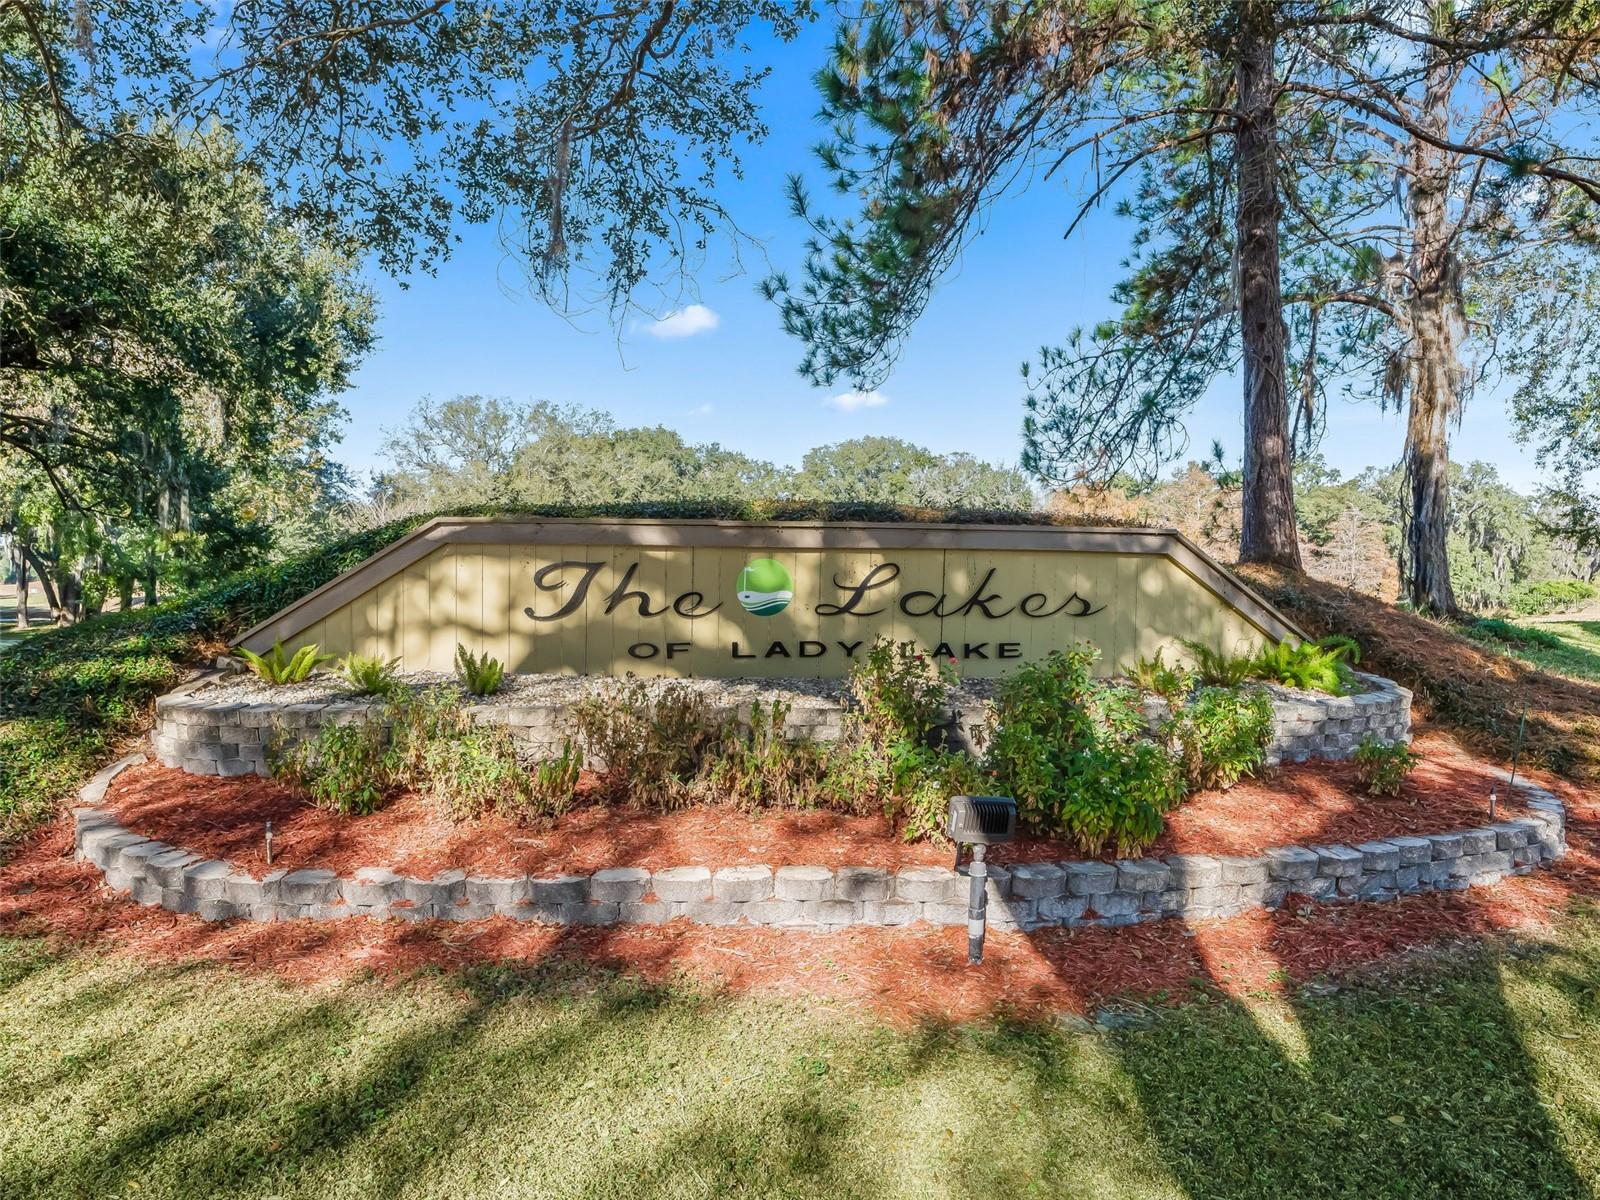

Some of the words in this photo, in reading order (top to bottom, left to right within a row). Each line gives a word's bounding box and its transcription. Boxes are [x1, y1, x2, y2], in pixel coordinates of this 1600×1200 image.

[524, 560, 722, 622] The
[814, 562, 1108, 619] Lakes
[628, 641, 691, 660] OF
[731, 640, 863, 660] LADY
